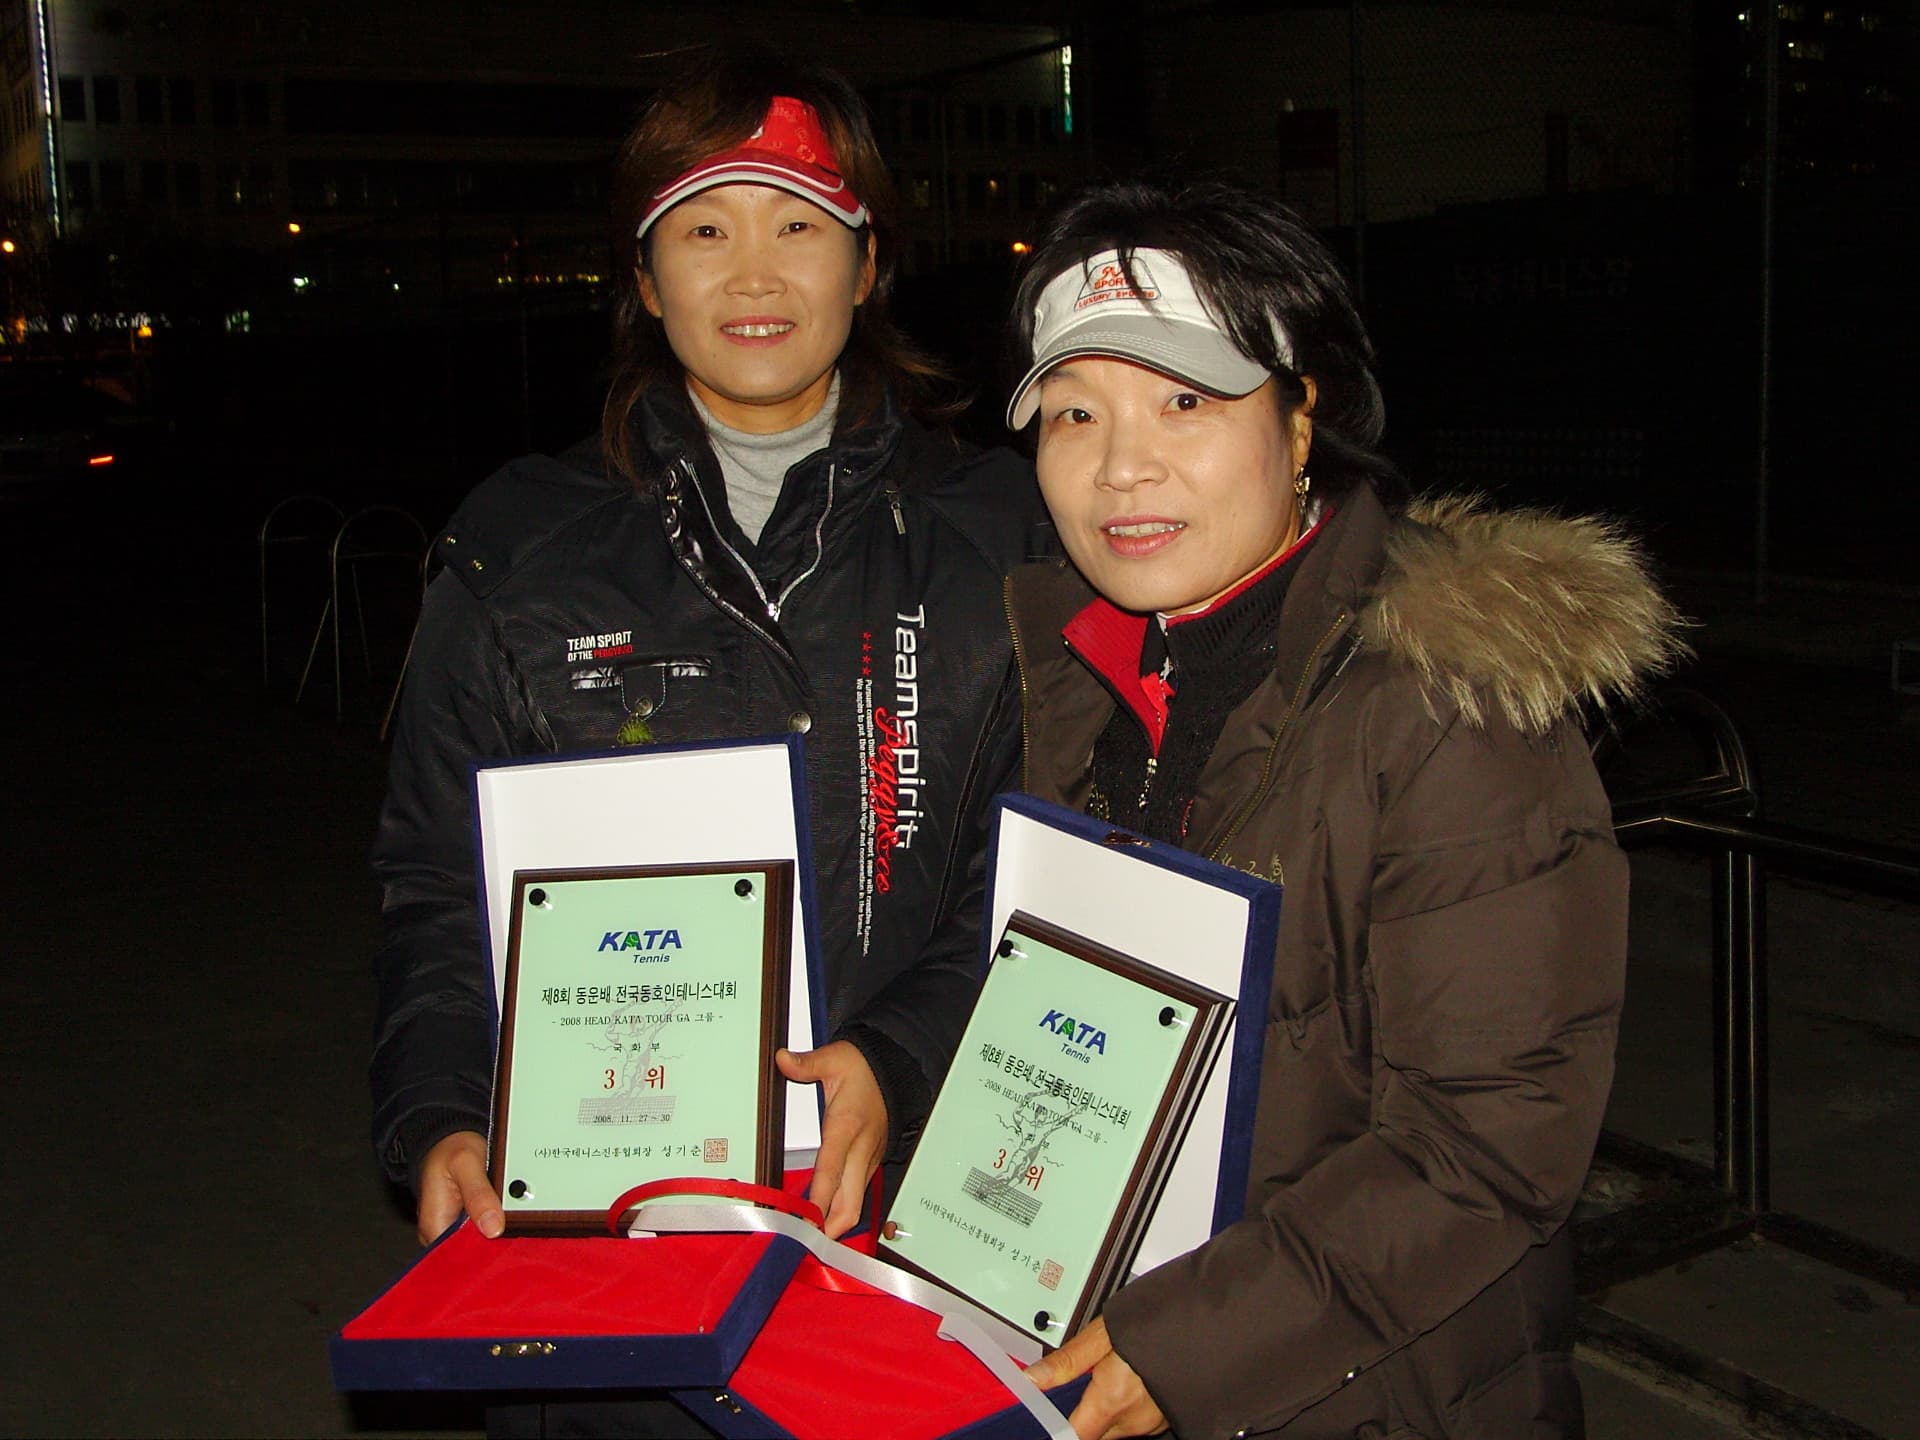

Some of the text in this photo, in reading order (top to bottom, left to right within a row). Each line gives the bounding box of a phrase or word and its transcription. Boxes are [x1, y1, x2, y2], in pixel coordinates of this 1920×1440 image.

[1079, 293, 1111, 308] LUXURY
[567, 631, 632, 651] TEAM SPIRIT
[568, 652, 578, 662] OF
[578, 650, 593, 660] THE
[856, 678, 864, 690] We
[856, 691, 864, 713] aspire
[858, 714, 865, 722] to
[866, 709, 874, 738] creative
[891, 604, 927, 849] Teamspirit
[857, 724, 865, 736] put
[859, 752, 867, 775] sports
[860, 813, 868, 831] vigor
[598, 929, 683, 952] KATA
[633, 953, 670, 964] Tennis
[542, 980, 737, 1006] 제8회 동운배 전국동호인테니스대회
[560, 1012, 714, 1026] 2008 HEAD KATA TOUR GA 그룹
[1039, 1009, 1106, 1056] KATA
[1062, 1043, 1090, 1064] Tennis
[603, 1064, 665, 1089] 3 위
[980, 1043, 1131, 1130] 제8회 동운배 전국동호인테니스대회
[985, 1079, 1001, 1093] 2008
[1002, 1087, 1023, 1104] HEAD
[592, 1115, 614, 1124] 2008.
[620, 1114, 632, 1123] 11.
[638, 1114, 648, 1122] 27
[660, 1113, 670, 1122] 30
[994, 1148, 1044, 1191] 3 위
